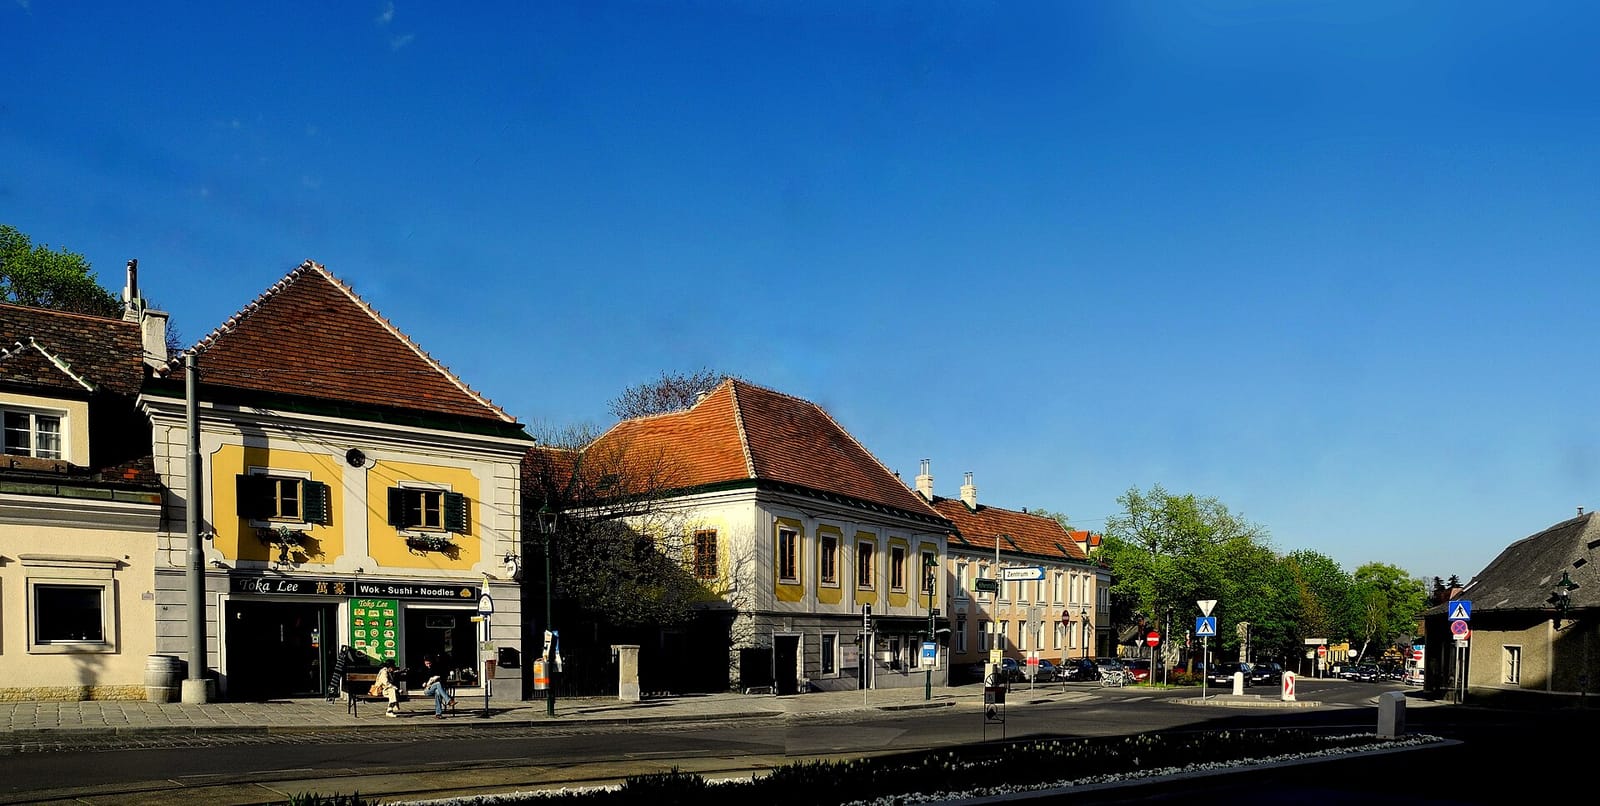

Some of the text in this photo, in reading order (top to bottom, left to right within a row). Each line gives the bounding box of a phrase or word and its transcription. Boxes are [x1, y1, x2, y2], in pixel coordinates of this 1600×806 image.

[239, 578, 299, 594] Toka Lee
[360, 585, 380, 594] Wok
[387, 586, 413, 595] Sushi
[420, 587, 455, 597] Noodles
[376, 600, 389, 608] Lee
